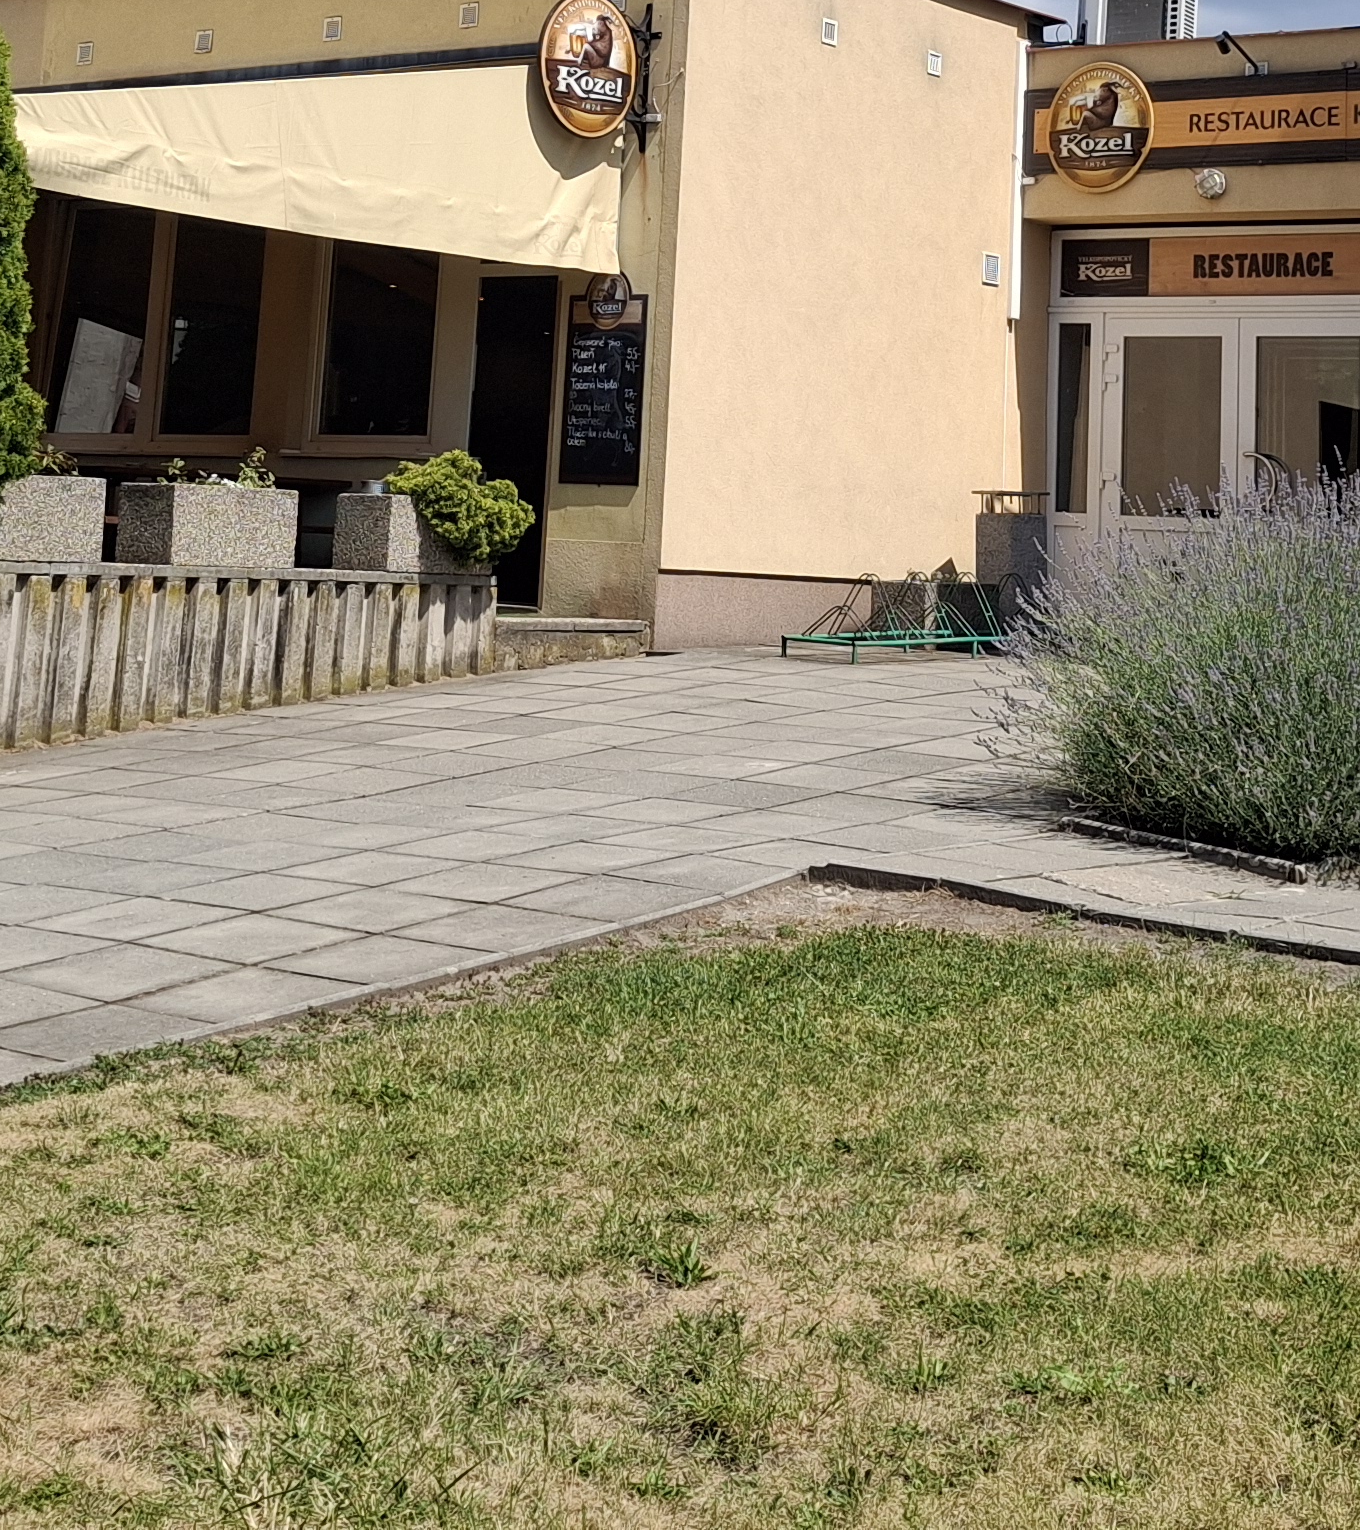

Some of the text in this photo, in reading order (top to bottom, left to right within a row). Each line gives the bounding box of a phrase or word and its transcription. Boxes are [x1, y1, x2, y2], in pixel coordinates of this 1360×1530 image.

[555, 65, 623, 102] Kozel
[1189, 105, 1341, 134] RESTAURACE
[1059, 132, 1134, 158] Kozel
[1077, 263, 1132, 281] Kozel
[1192, 251, 1334, 279] RESTAURACE
[592, 301, 622, 314] Kozel
[571, 362, 597, 374] Kozel
